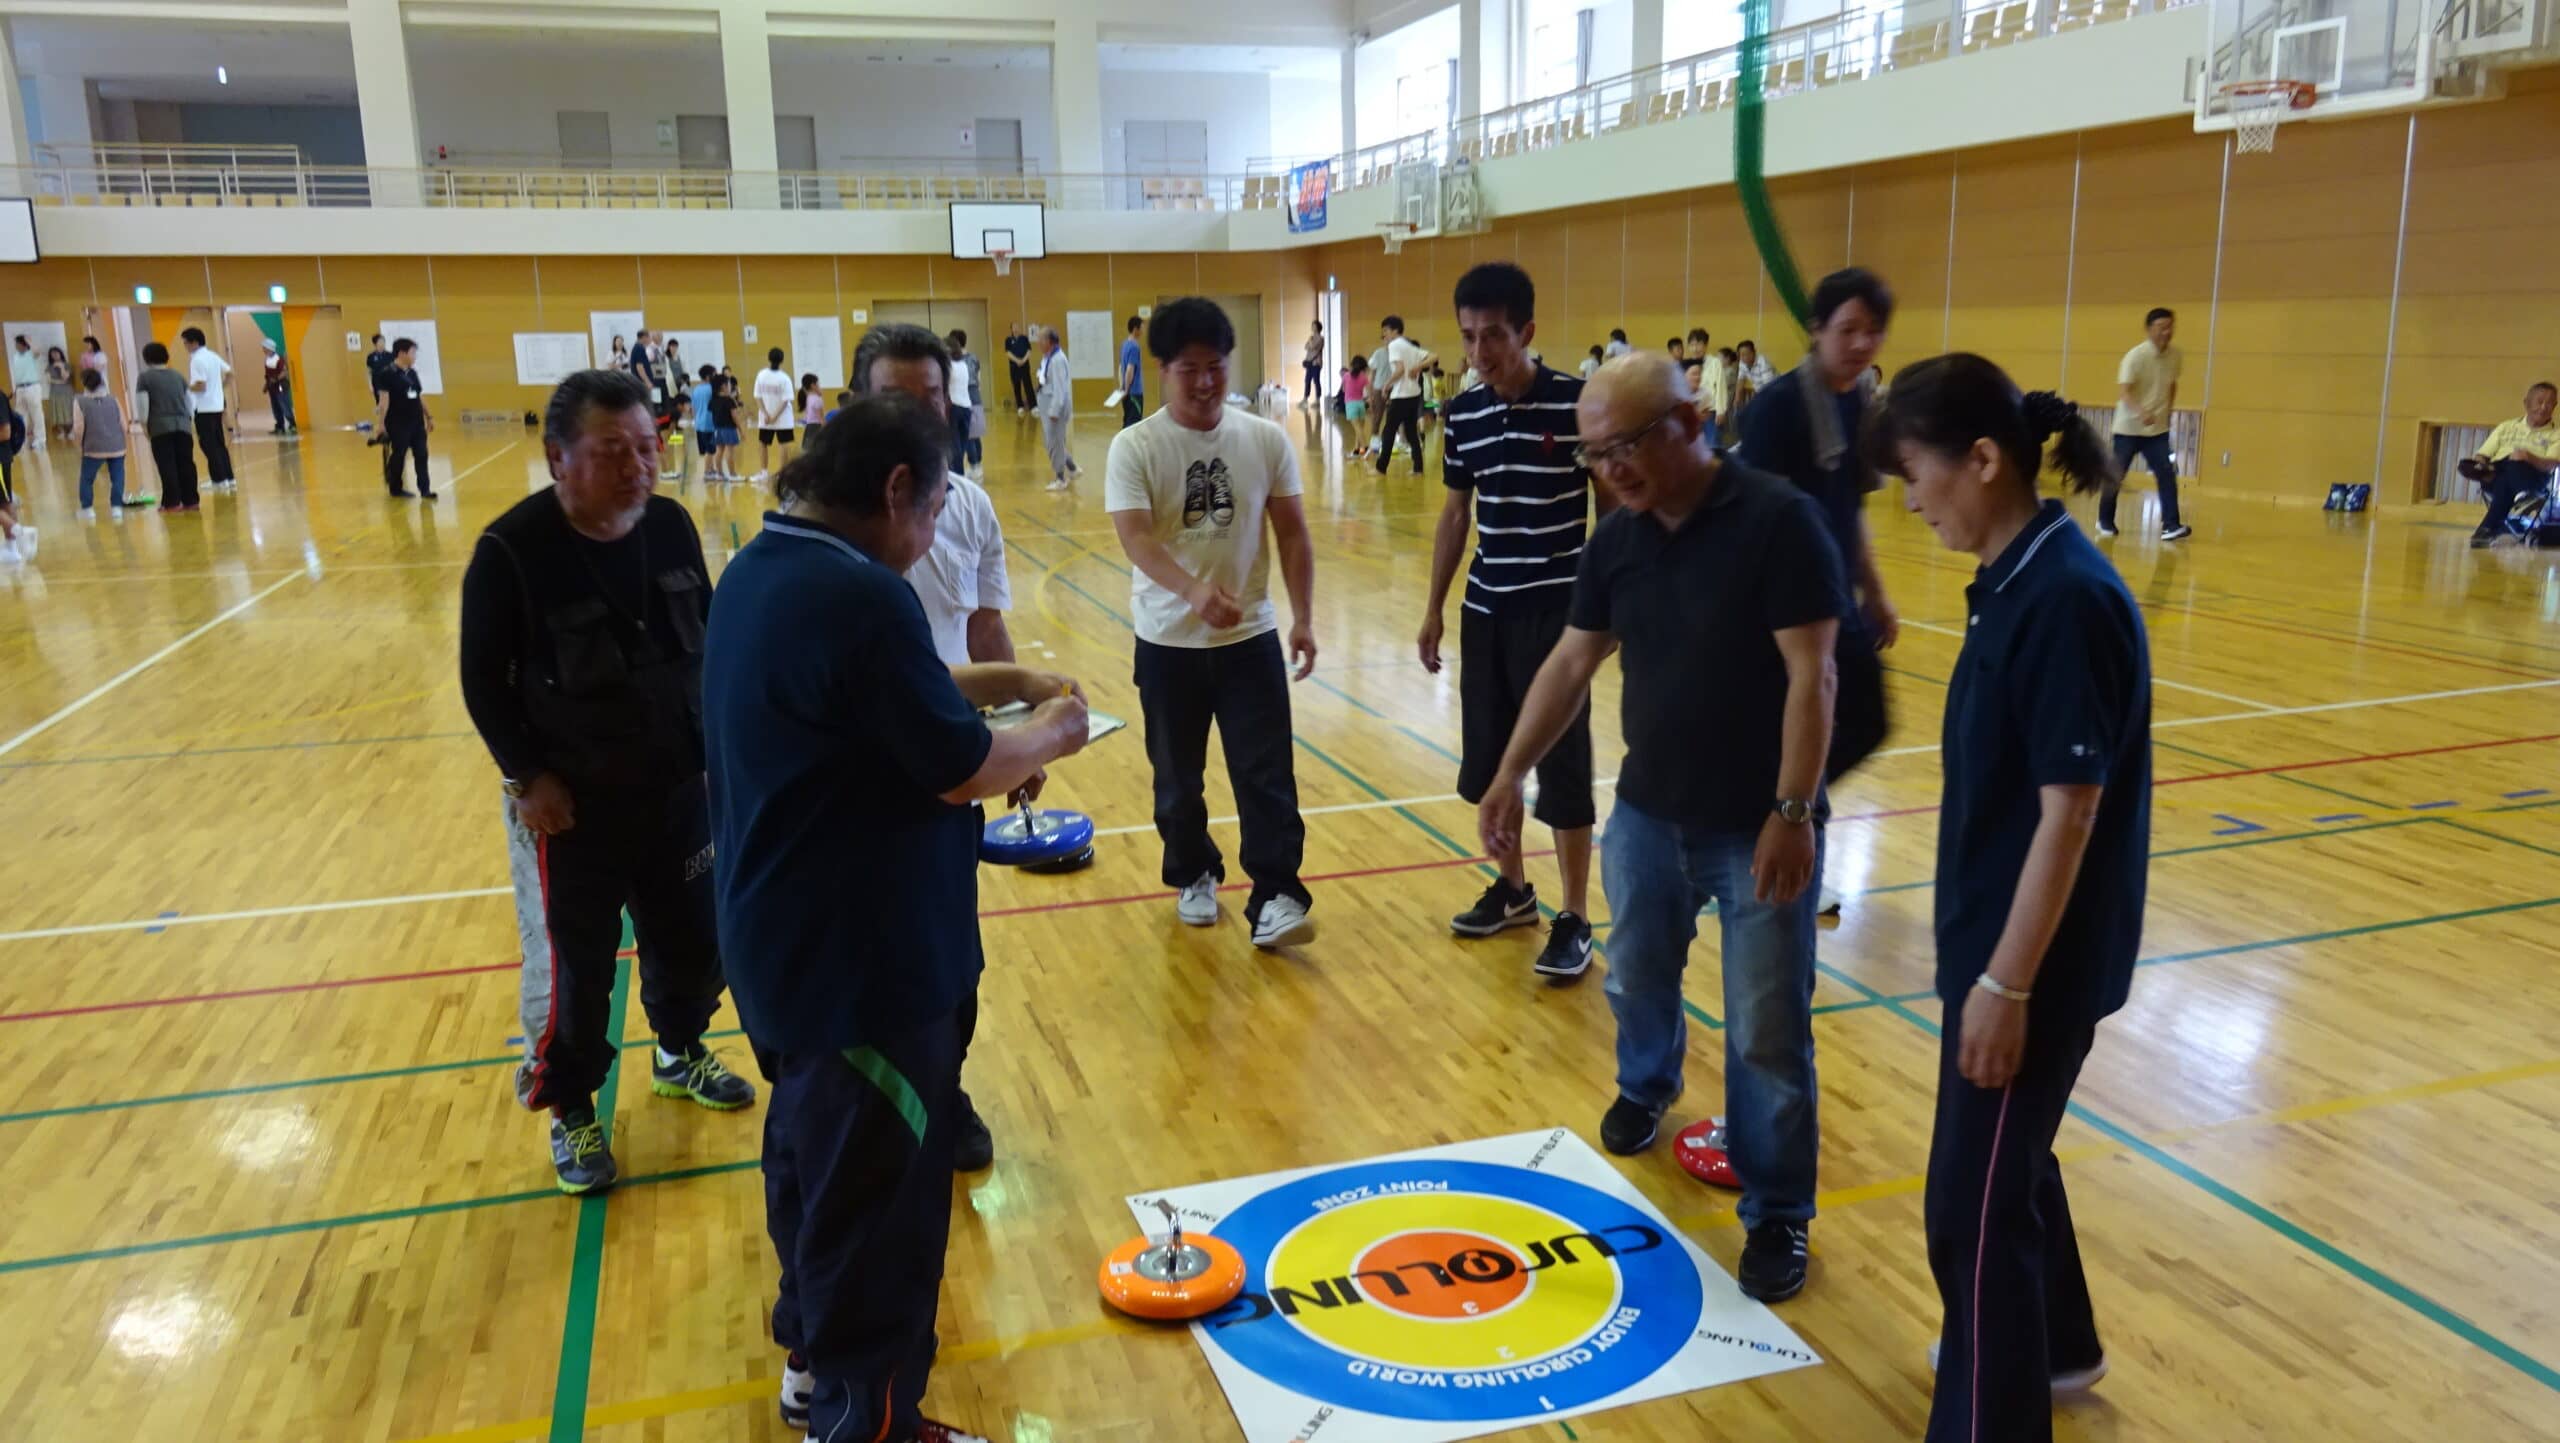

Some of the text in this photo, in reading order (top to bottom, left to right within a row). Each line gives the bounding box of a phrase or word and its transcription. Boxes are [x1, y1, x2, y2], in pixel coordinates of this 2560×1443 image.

[1311, 1179, 1448, 1211] POINT ZONE
[1462, 1300, 1479, 1315] 3
[1348, 1306, 1641, 1388] ENJOY CUROLLING WORLD
[1495, 1345, 1515, 1360] 2
[1539, 1395, 1555, 1411] 1
